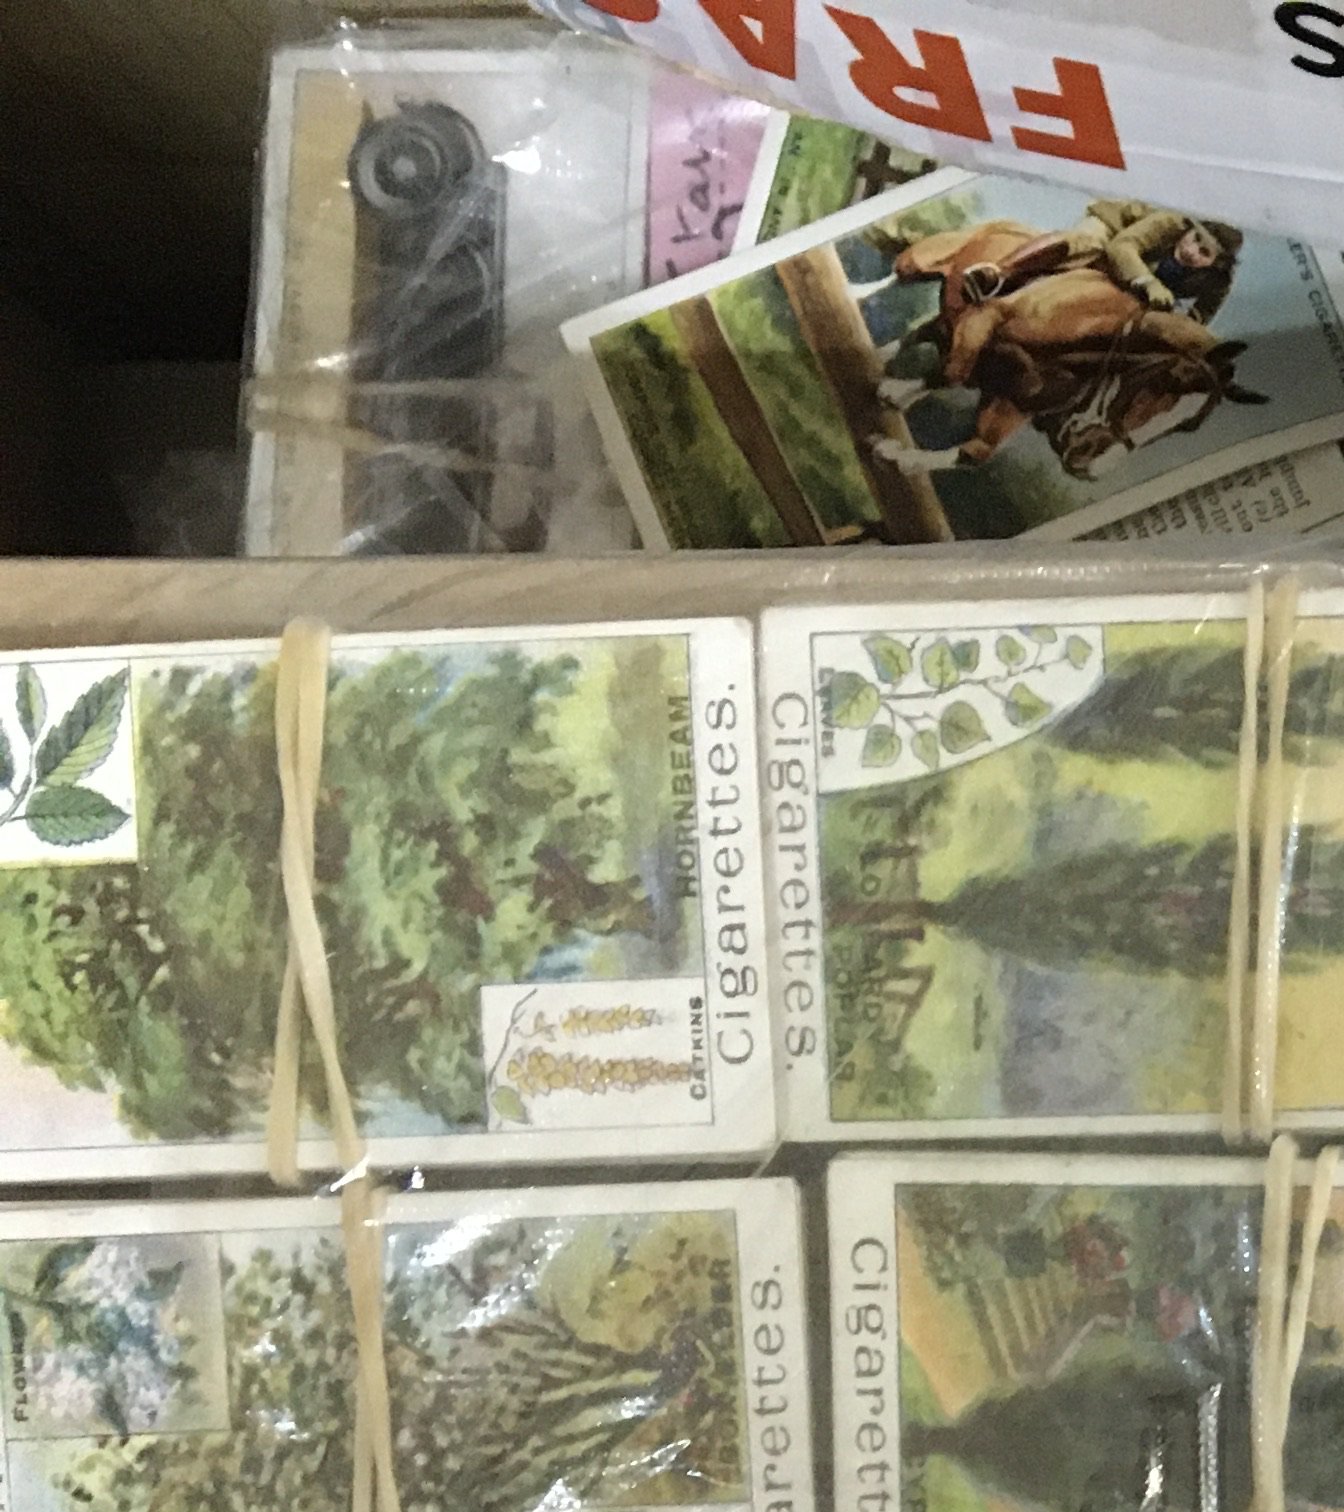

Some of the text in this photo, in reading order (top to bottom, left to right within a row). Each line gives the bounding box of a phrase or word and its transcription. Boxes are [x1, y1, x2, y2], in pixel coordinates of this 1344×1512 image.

[583, 0, 1126, 170] FRA
[667, 694, 699, 899] HORNBEAM
[705, 681, 759, 1066] Cigarettes.
[769, 690, 818, 1072] Cigarettes.
[689, 996, 707, 1101] CATKINS
